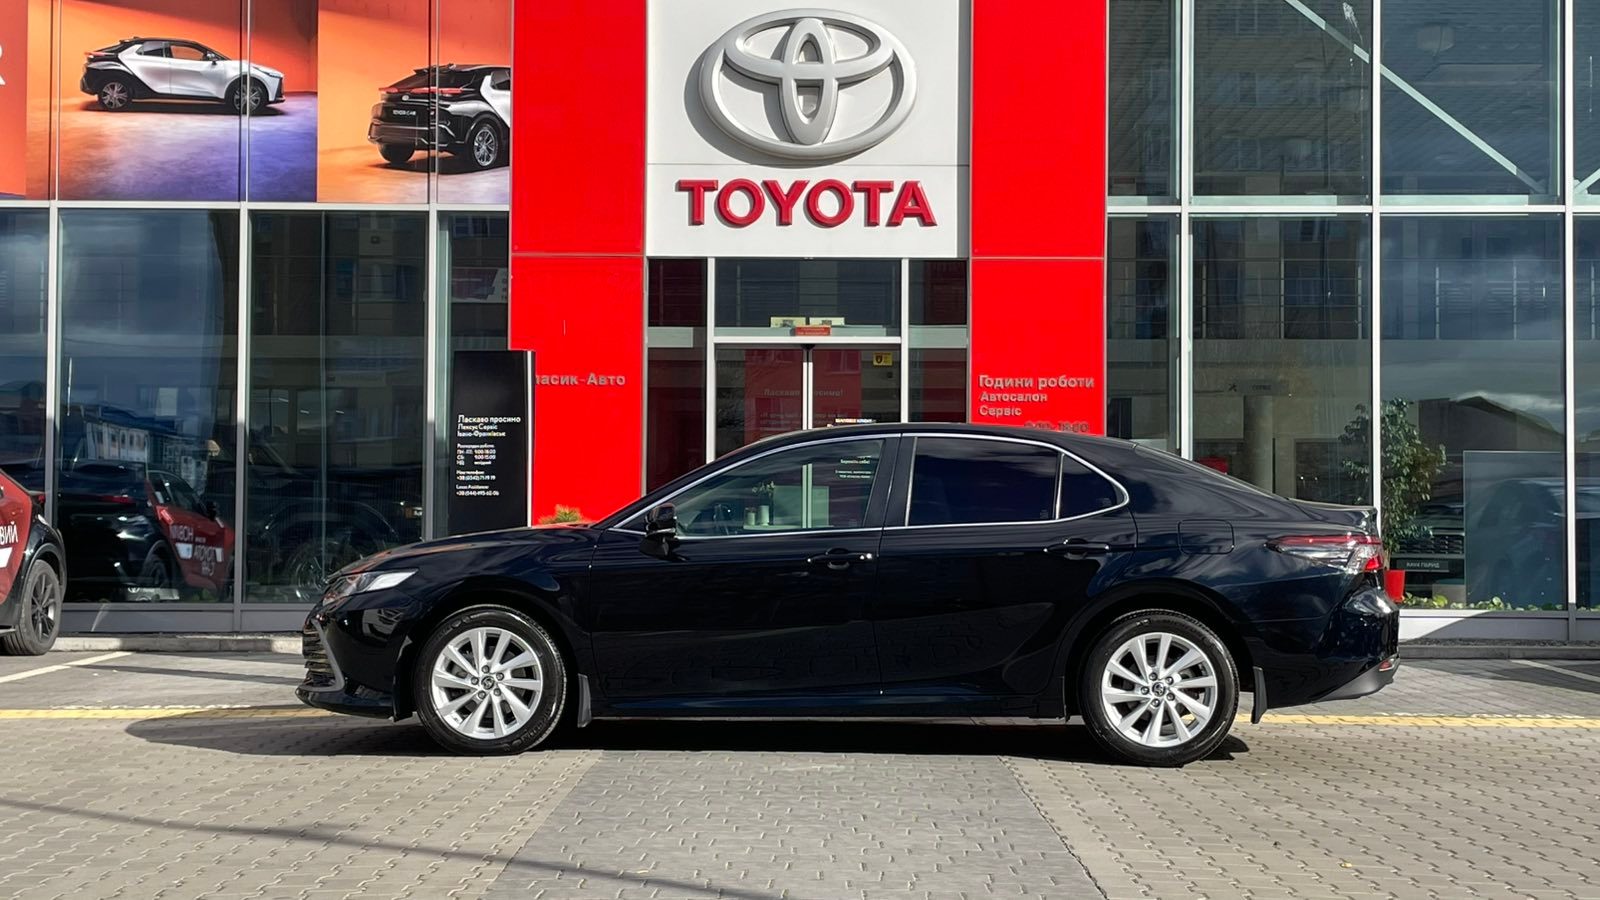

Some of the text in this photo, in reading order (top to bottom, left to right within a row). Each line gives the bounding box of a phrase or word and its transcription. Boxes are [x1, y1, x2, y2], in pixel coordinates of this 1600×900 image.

[676, 178, 937, 227] TOYOTA
[979, 374, 1095, 390] Години роботи
[980, 391, 1048, 402] Автосалон
[979, 404, 1022, 417] Сервіс
[458, 415, 521, 424] Ласкаво просимо
